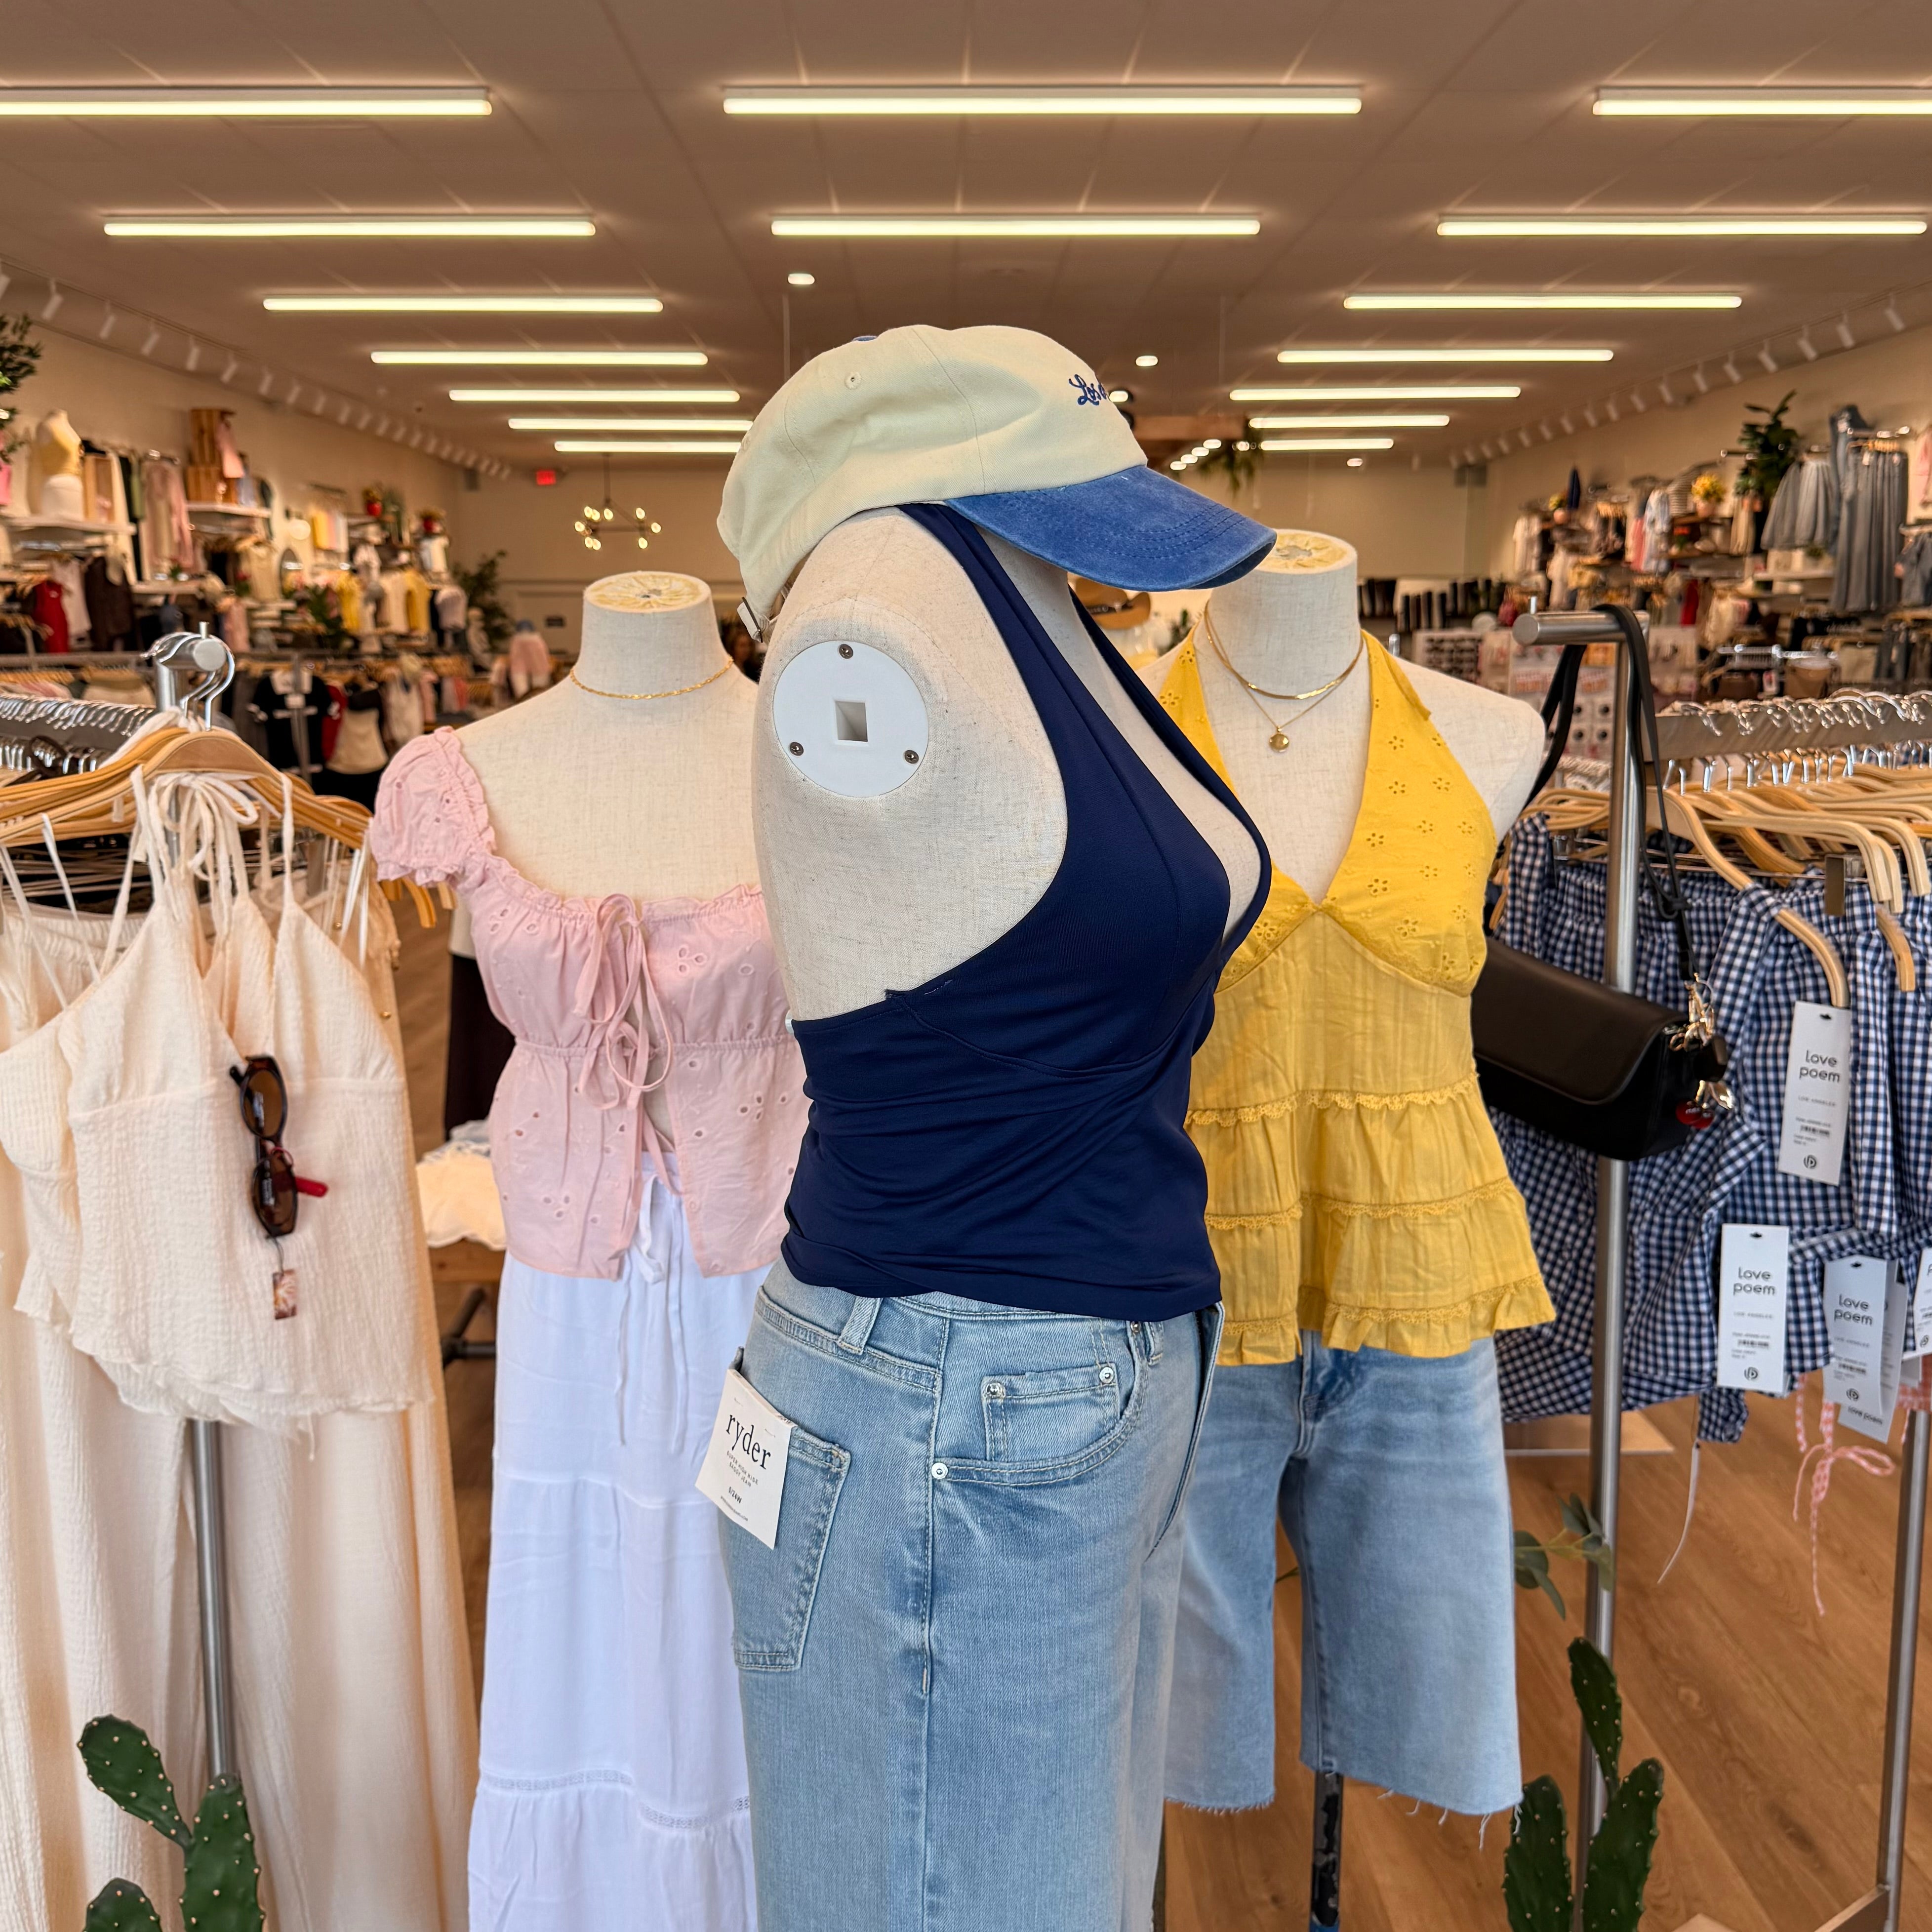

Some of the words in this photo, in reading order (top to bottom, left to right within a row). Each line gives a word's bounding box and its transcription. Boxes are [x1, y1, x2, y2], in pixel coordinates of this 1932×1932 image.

[1799, 1066, 1841, 1083] poem
[1733, 1283, 1776, 1296] poem
[1834, 1309, 1873, 1326] poem
[726, 1414, 771, 1470] ryder
